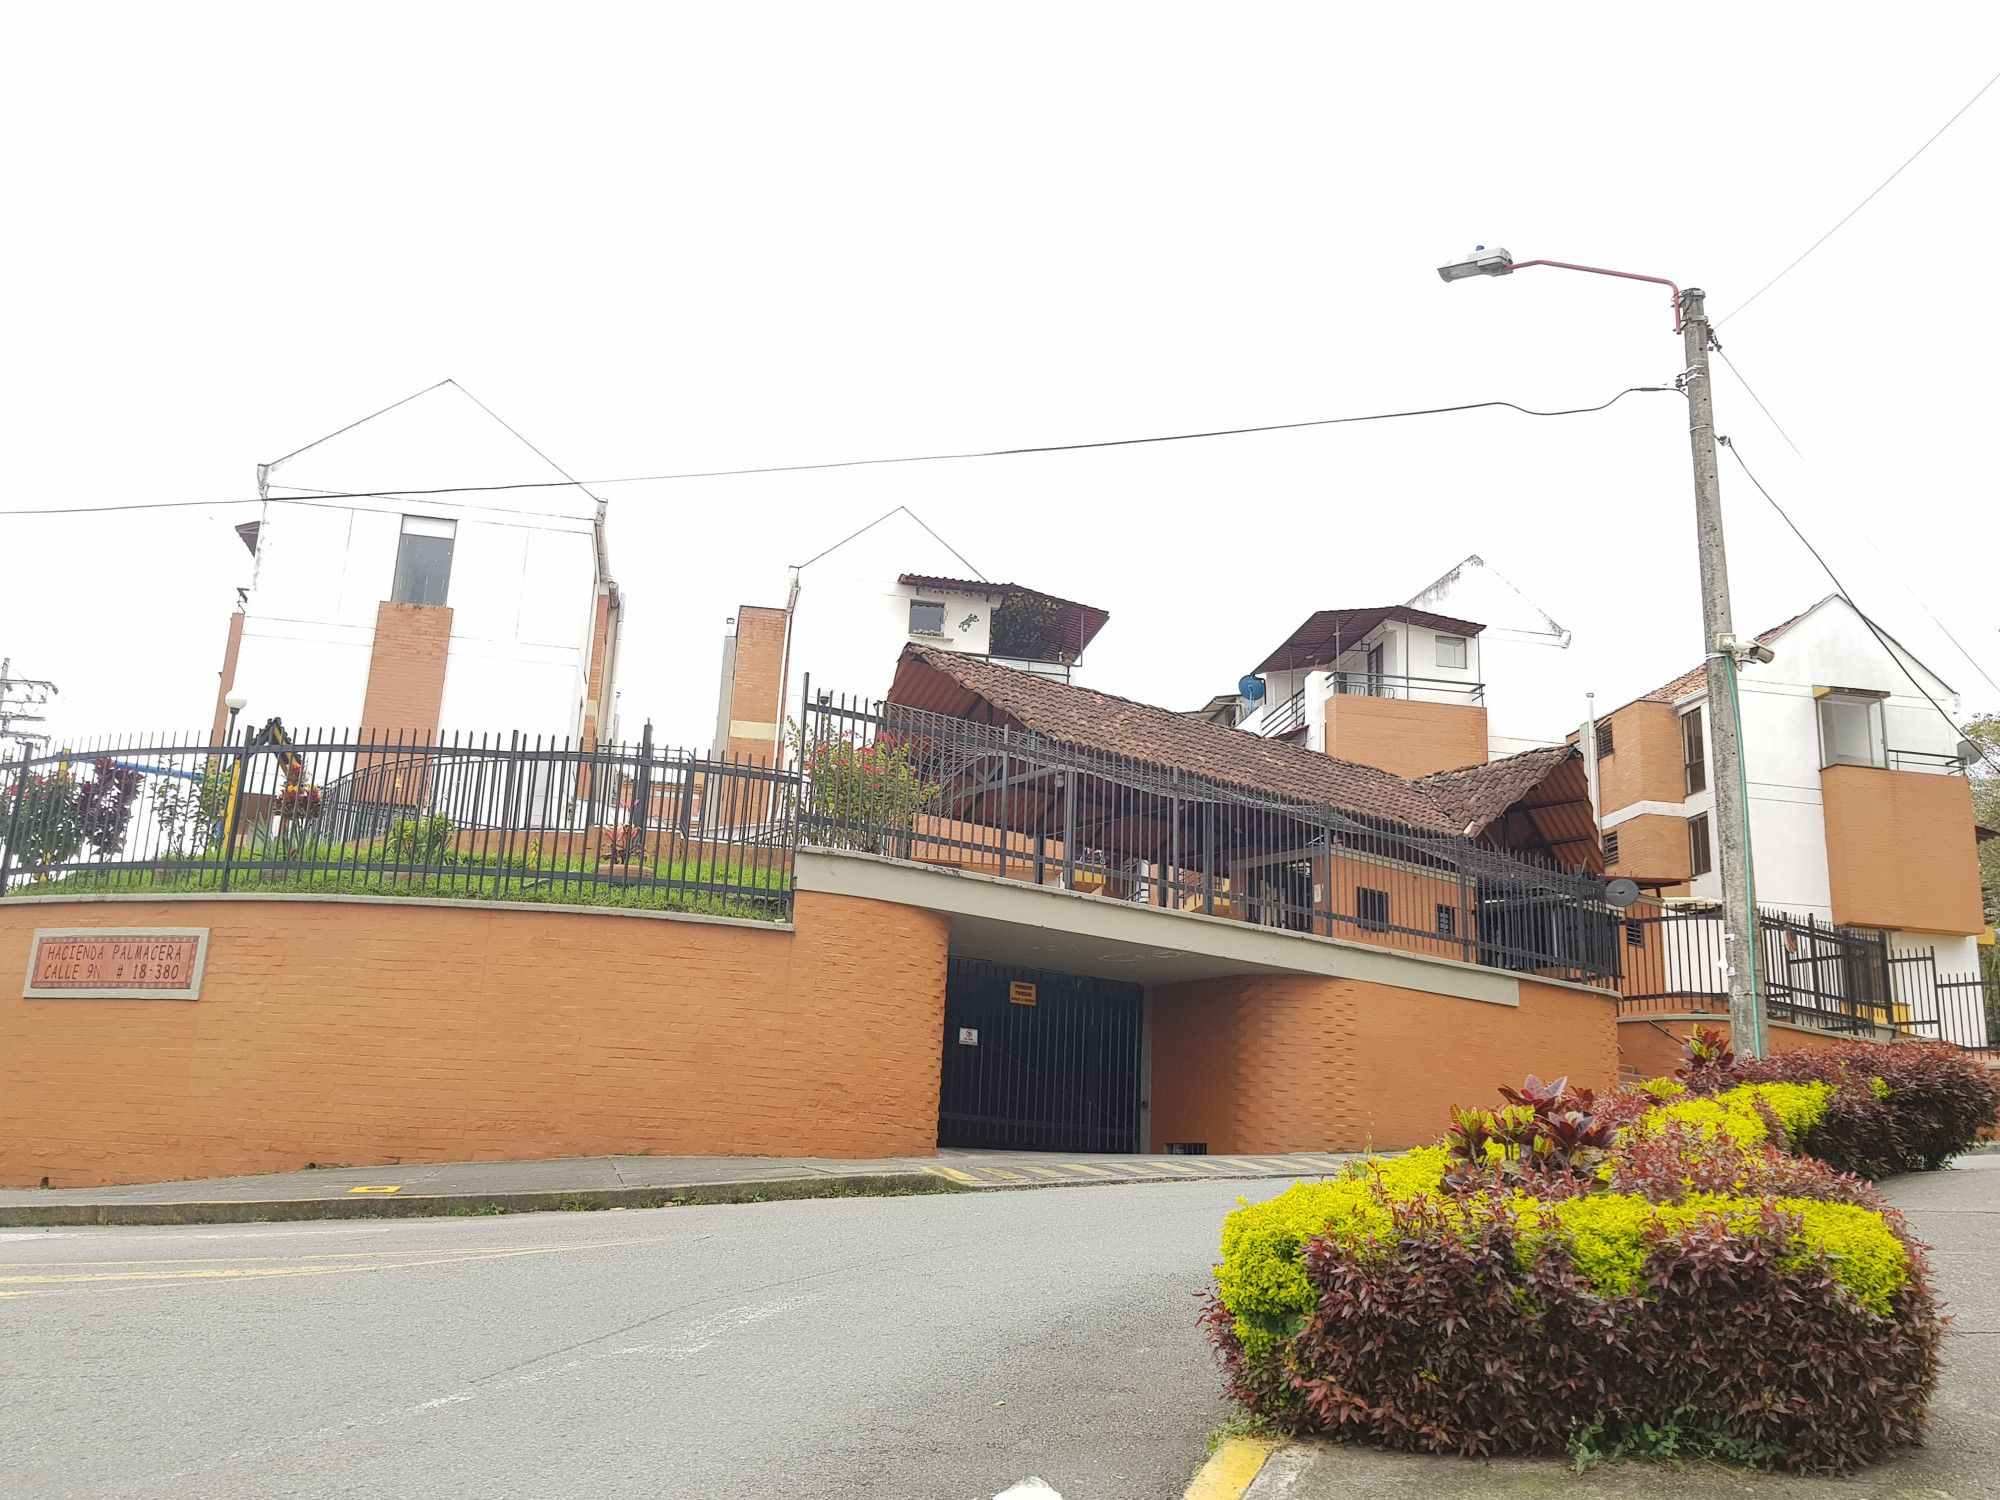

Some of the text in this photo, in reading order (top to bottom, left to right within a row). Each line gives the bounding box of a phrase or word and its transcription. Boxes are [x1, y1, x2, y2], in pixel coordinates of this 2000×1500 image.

[47, 944, 182, 961] HACIENDA PALMACERA
[44, 963, 179, 980] CALLE 9N # 18-380
